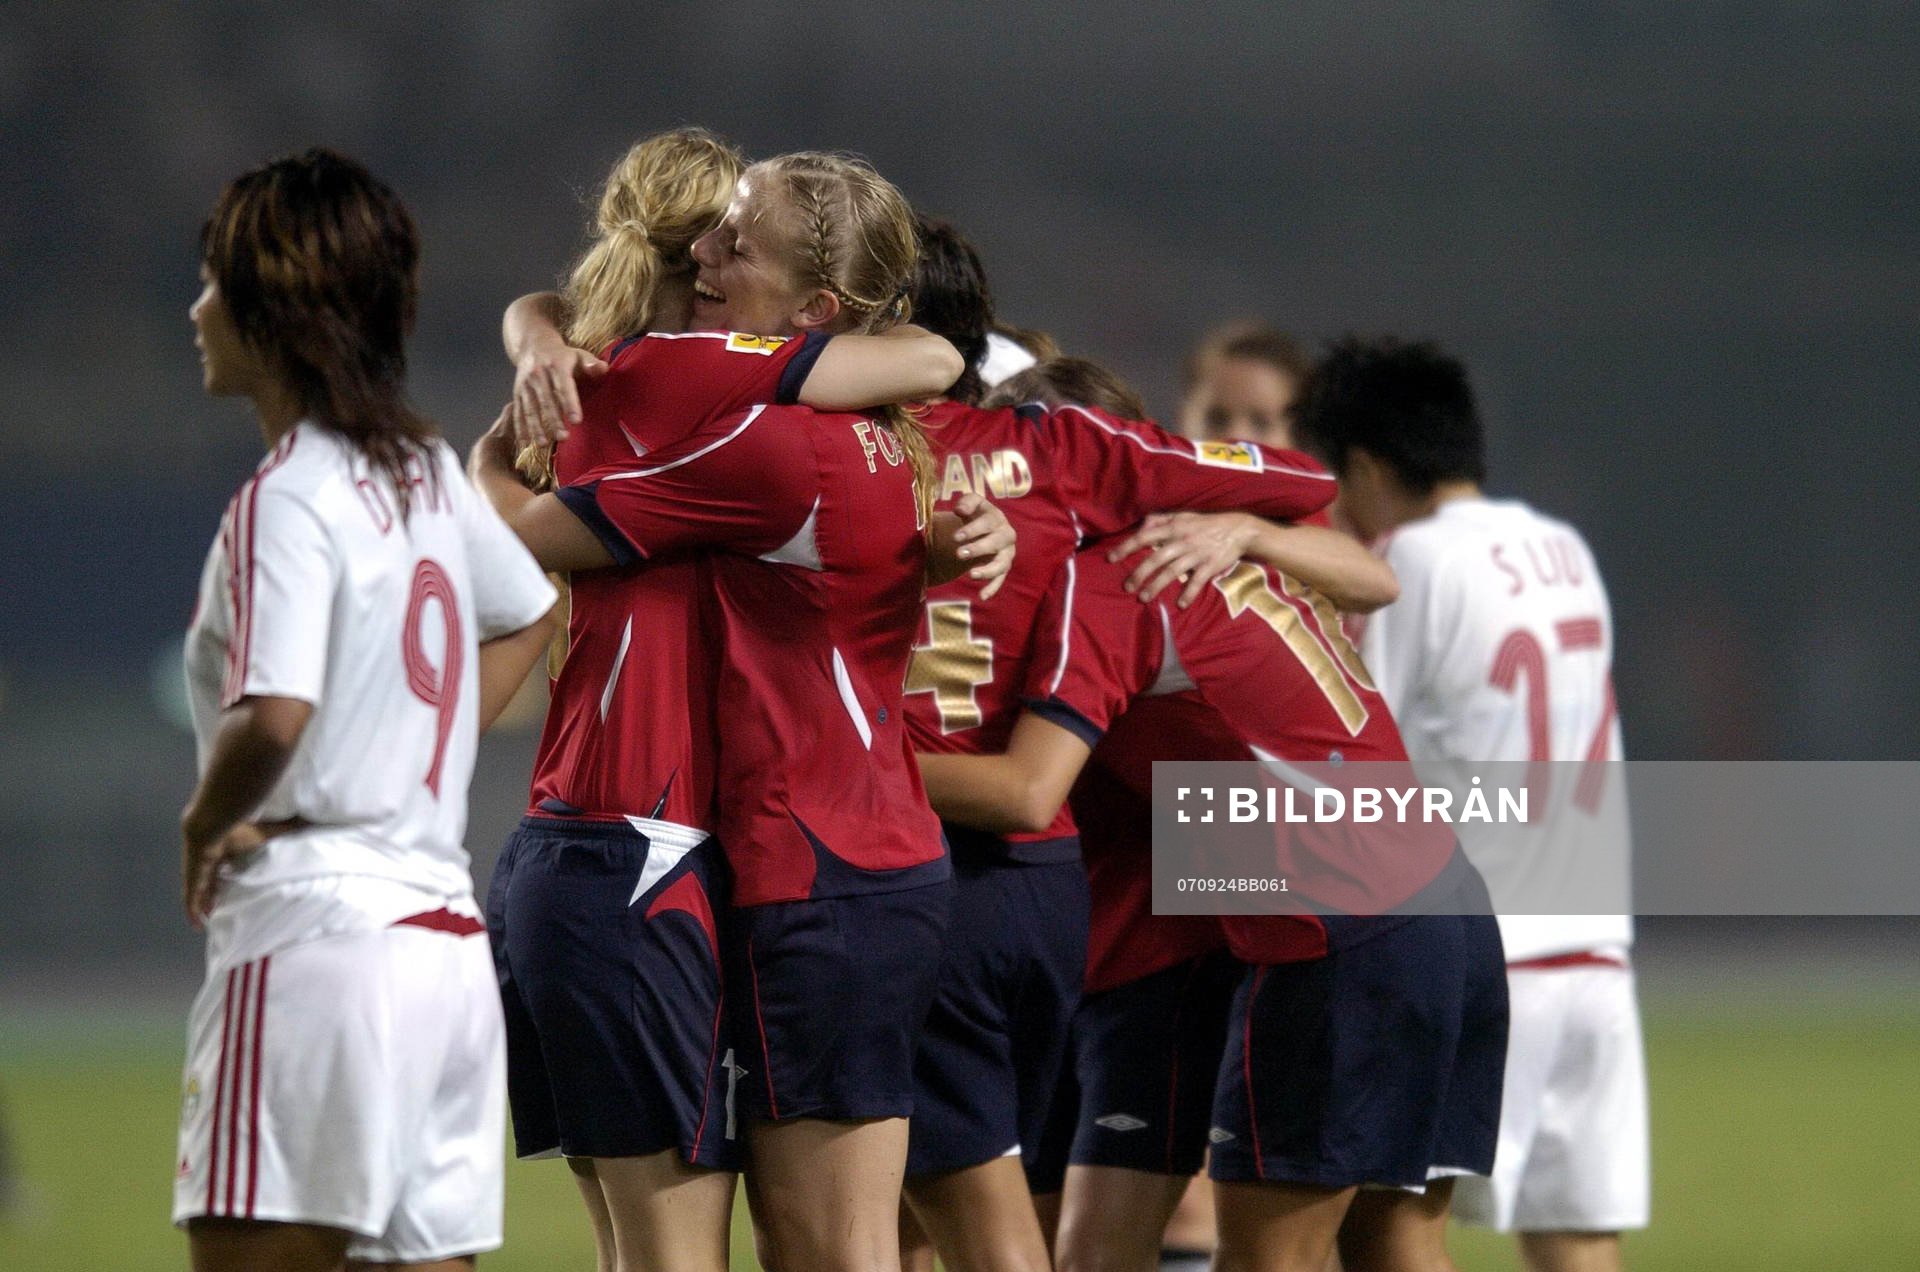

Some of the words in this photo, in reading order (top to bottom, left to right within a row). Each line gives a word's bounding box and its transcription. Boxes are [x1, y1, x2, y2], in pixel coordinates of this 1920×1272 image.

[934, 449, 1033, 501] AND
[402, 559, 464, 801] 9
[1488, 617, 1619, 829] 17
